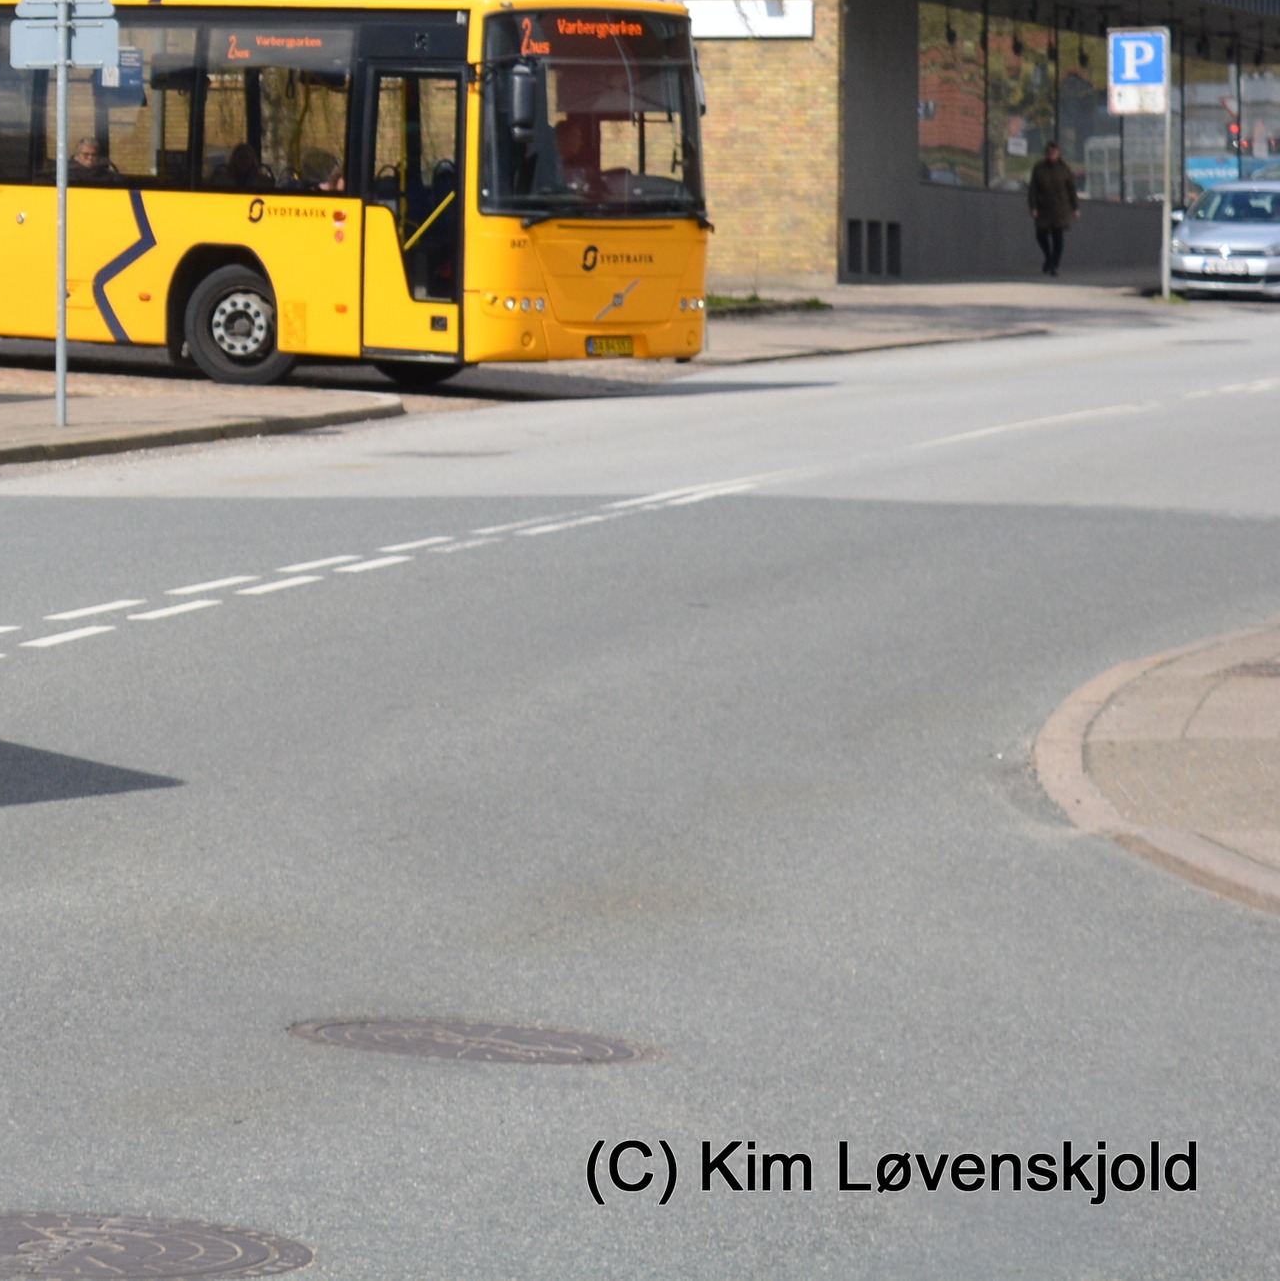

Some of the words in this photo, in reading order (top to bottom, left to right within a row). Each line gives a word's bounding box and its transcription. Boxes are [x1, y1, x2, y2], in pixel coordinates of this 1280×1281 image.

[521, 18, 531, 55] 2
[1121, 41, 1155, 80] P
[267, 206, 327, 218] SYDTRAFIK
[600, 254, 654, 264] SYDTRAFIK
